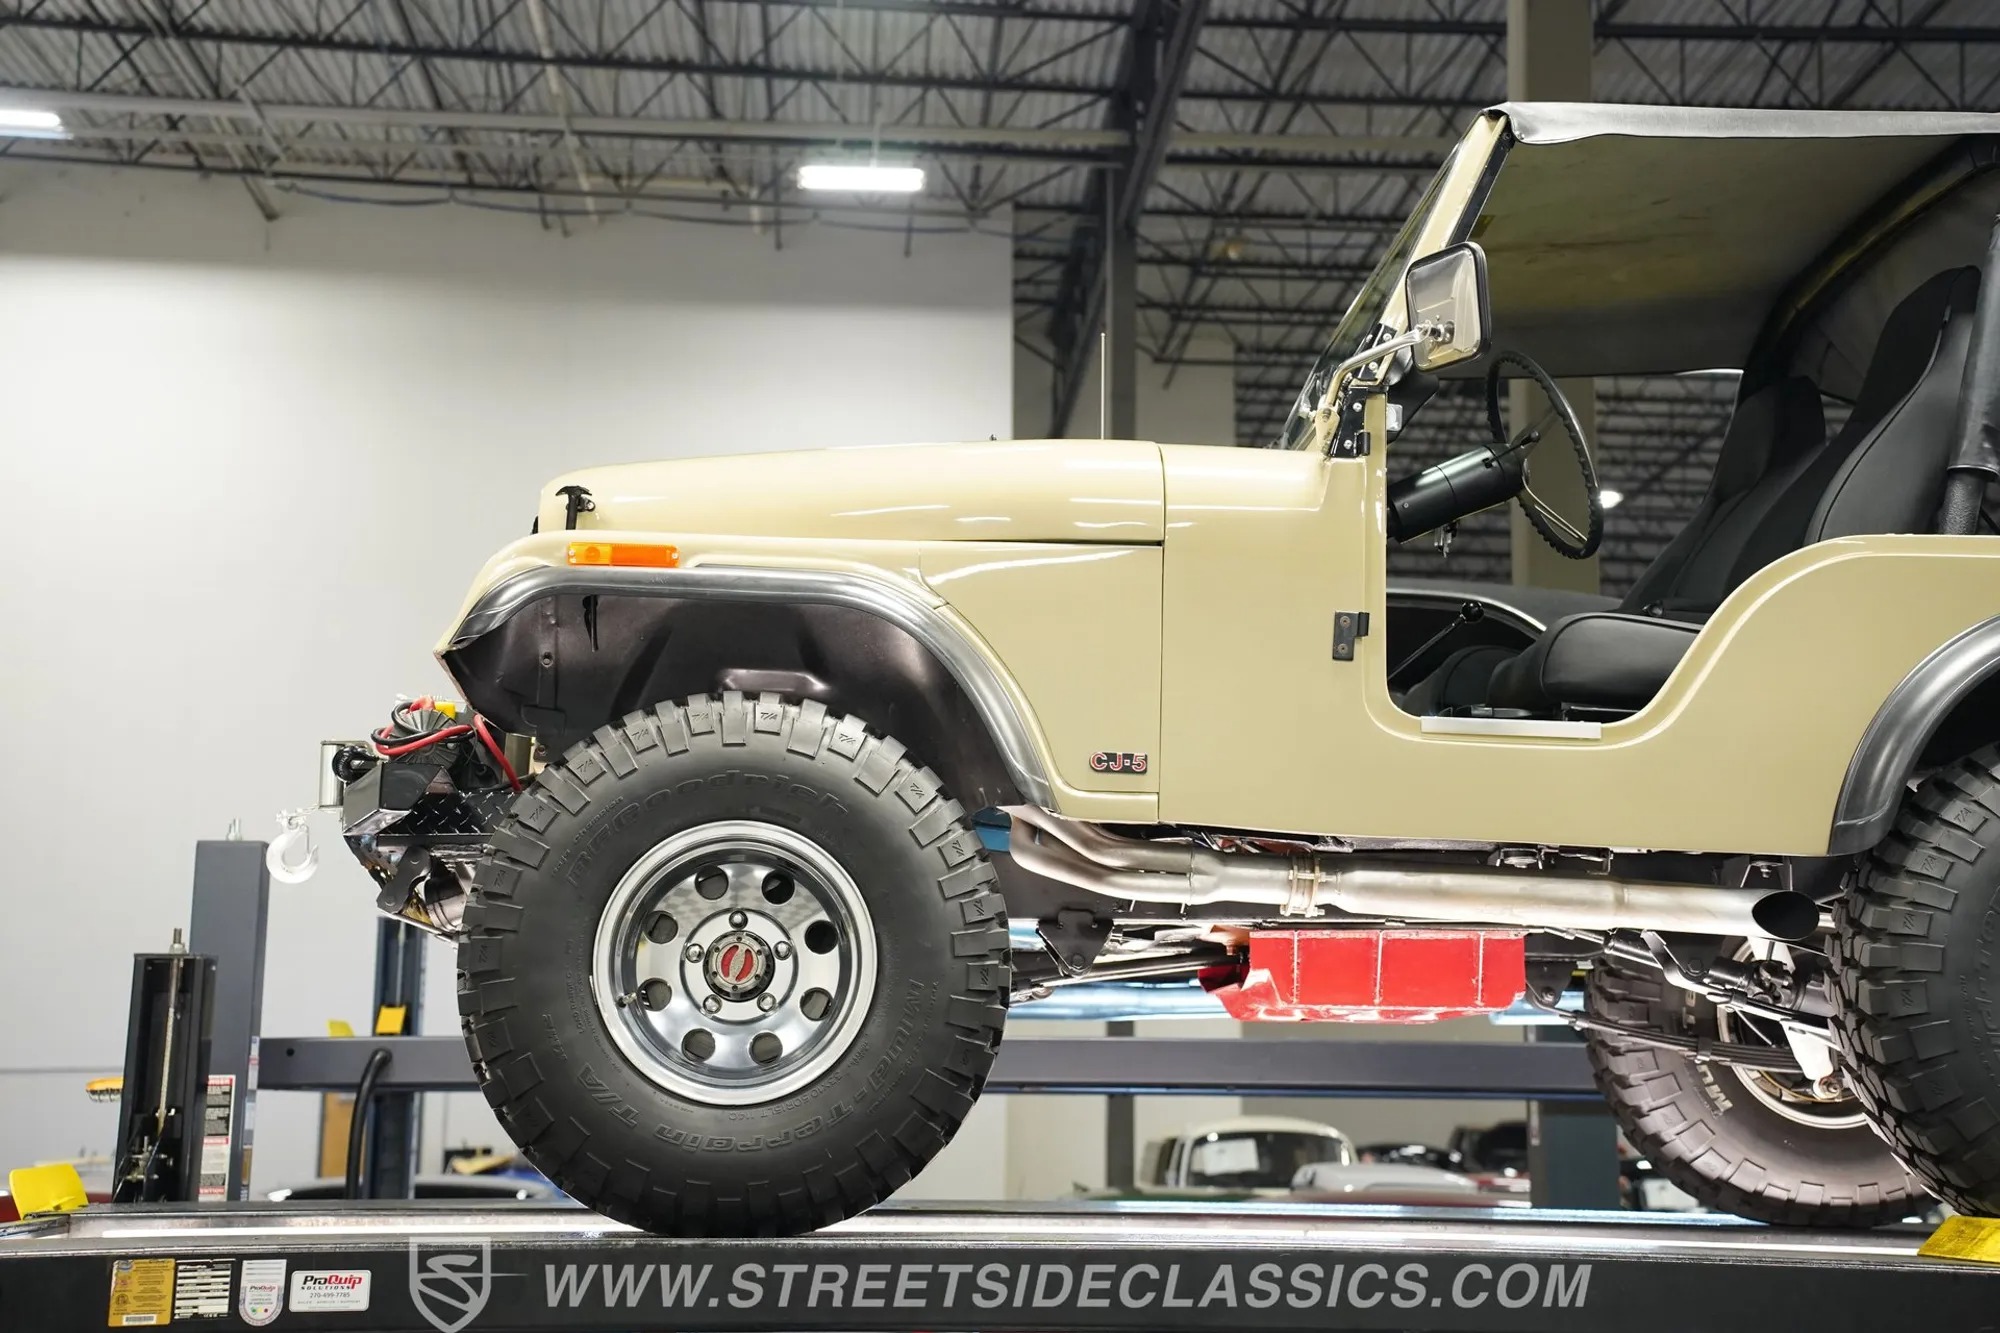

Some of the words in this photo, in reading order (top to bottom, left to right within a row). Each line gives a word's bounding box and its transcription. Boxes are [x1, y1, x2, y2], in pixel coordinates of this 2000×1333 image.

[760, 710, 777, 721] T/A
[837, 731, 856, 746] T/A
[1090, 752, 1146, 772] CJ-5
[907, 782, 925, 799] T/A
[576, 1063, 639, 1128] T/A
[303, 1274, 362, 1289] ProQuip
